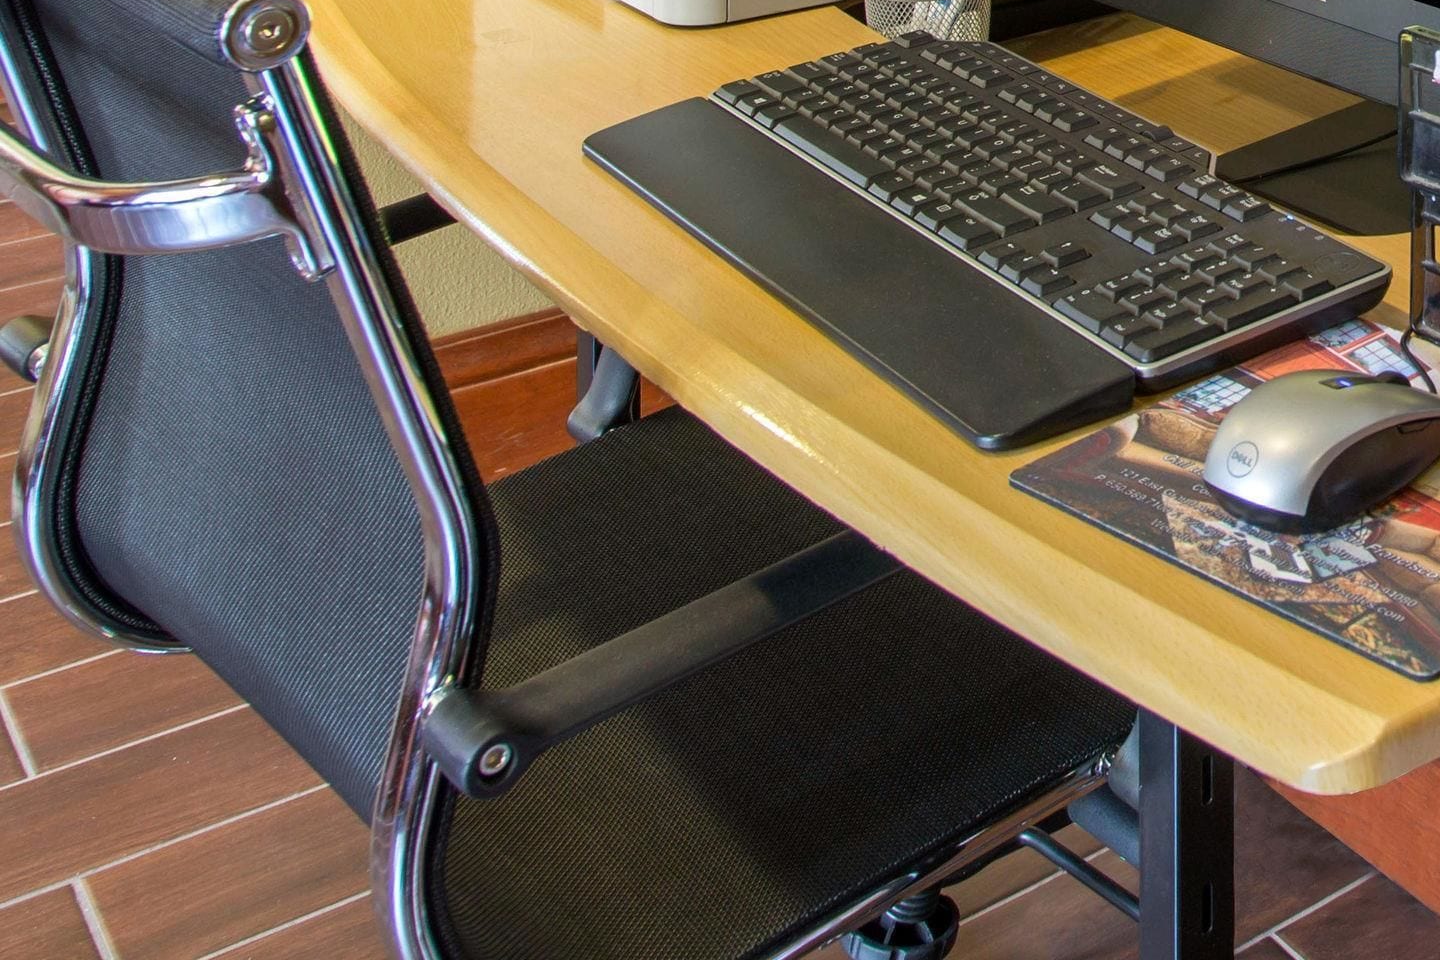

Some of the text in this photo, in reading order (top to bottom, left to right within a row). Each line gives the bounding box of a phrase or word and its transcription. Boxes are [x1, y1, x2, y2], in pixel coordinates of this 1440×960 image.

[1231, 450, 1253, 468] DELL
[1120, 468, 1138, 480] 121
[1138, 476, 1165, 492] East
